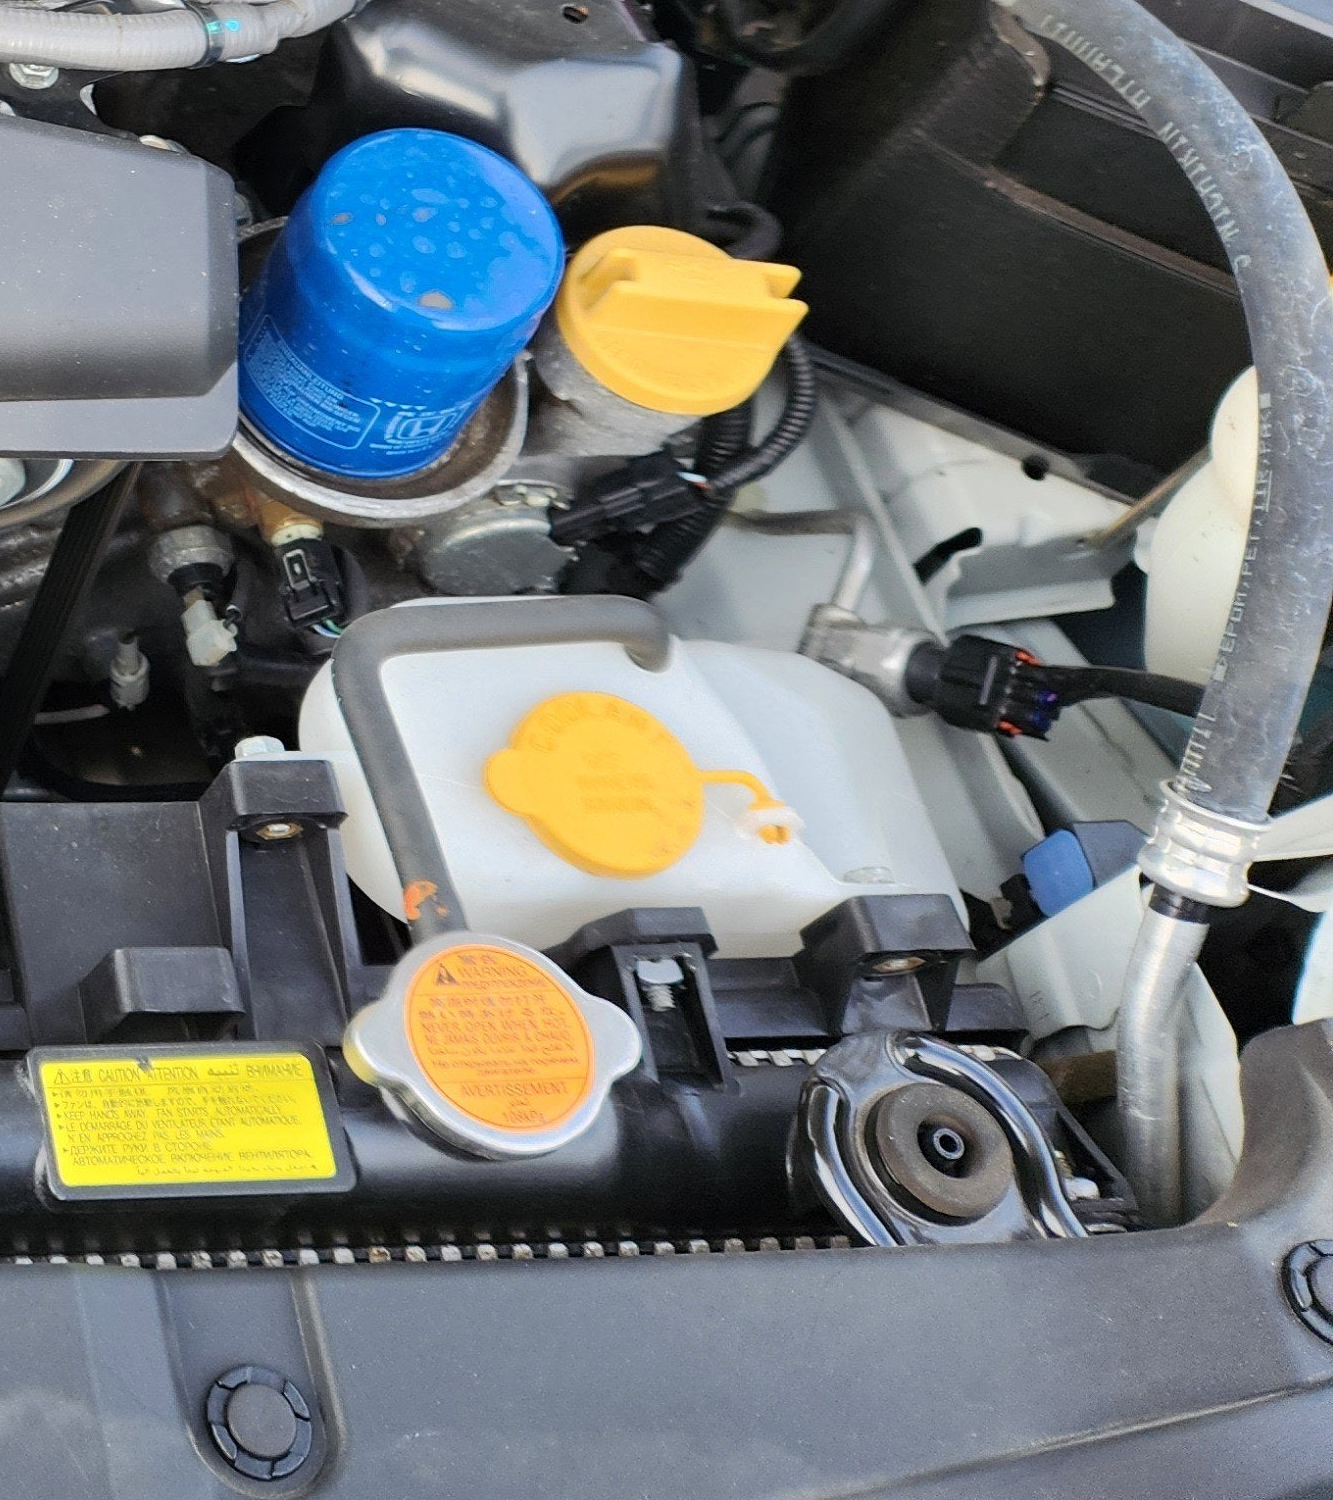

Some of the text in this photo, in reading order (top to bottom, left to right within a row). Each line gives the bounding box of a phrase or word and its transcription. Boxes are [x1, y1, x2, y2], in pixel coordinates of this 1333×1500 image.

[98, 1066, 200, 1083] CAUTION ATTENTION
[63, 1111, 85, 1121] KEEP
[89, 1110, 119, 1120] HANDS
[156, 1108, 173, 1117] FAN
